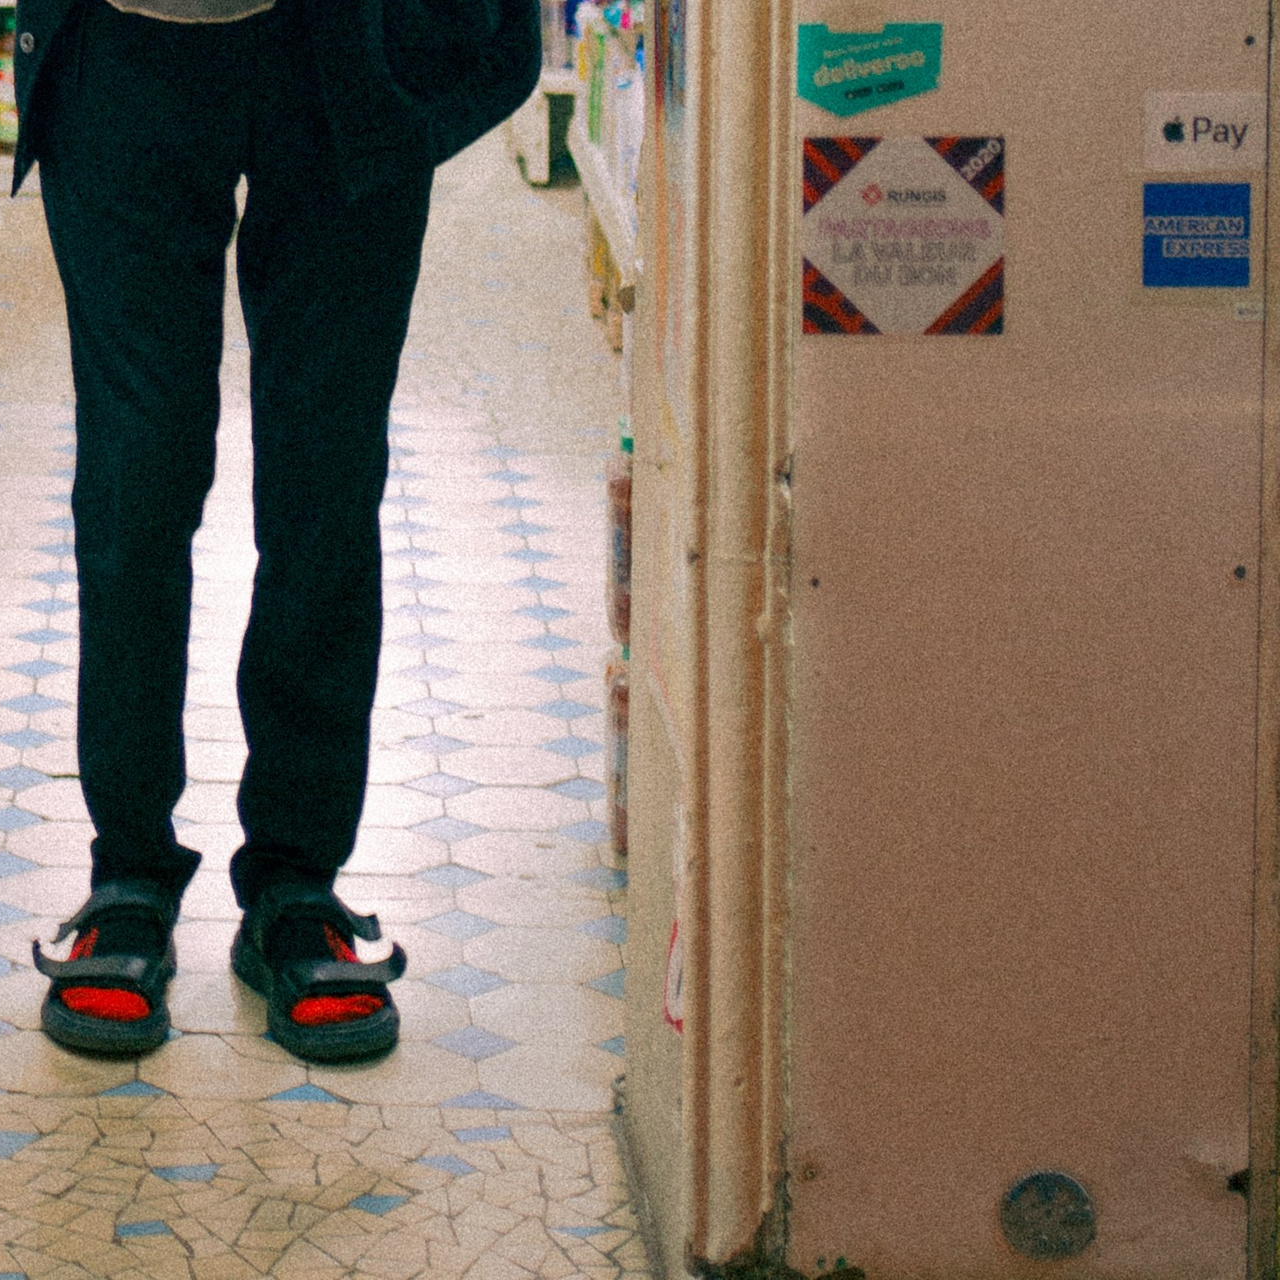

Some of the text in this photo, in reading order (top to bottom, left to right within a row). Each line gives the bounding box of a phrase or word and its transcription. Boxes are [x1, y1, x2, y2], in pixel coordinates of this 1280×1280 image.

[813, 50, 926, 88] deliveroo
[1192, 116, 1248, 150] Pay
[959, 139, 1002, 182] 2020
[887, 189, 947, 203] RUNGIS
[1145, 217, 1243, 235] AMERICAN
[1164, 240, 1249, 257] EXPRESS
